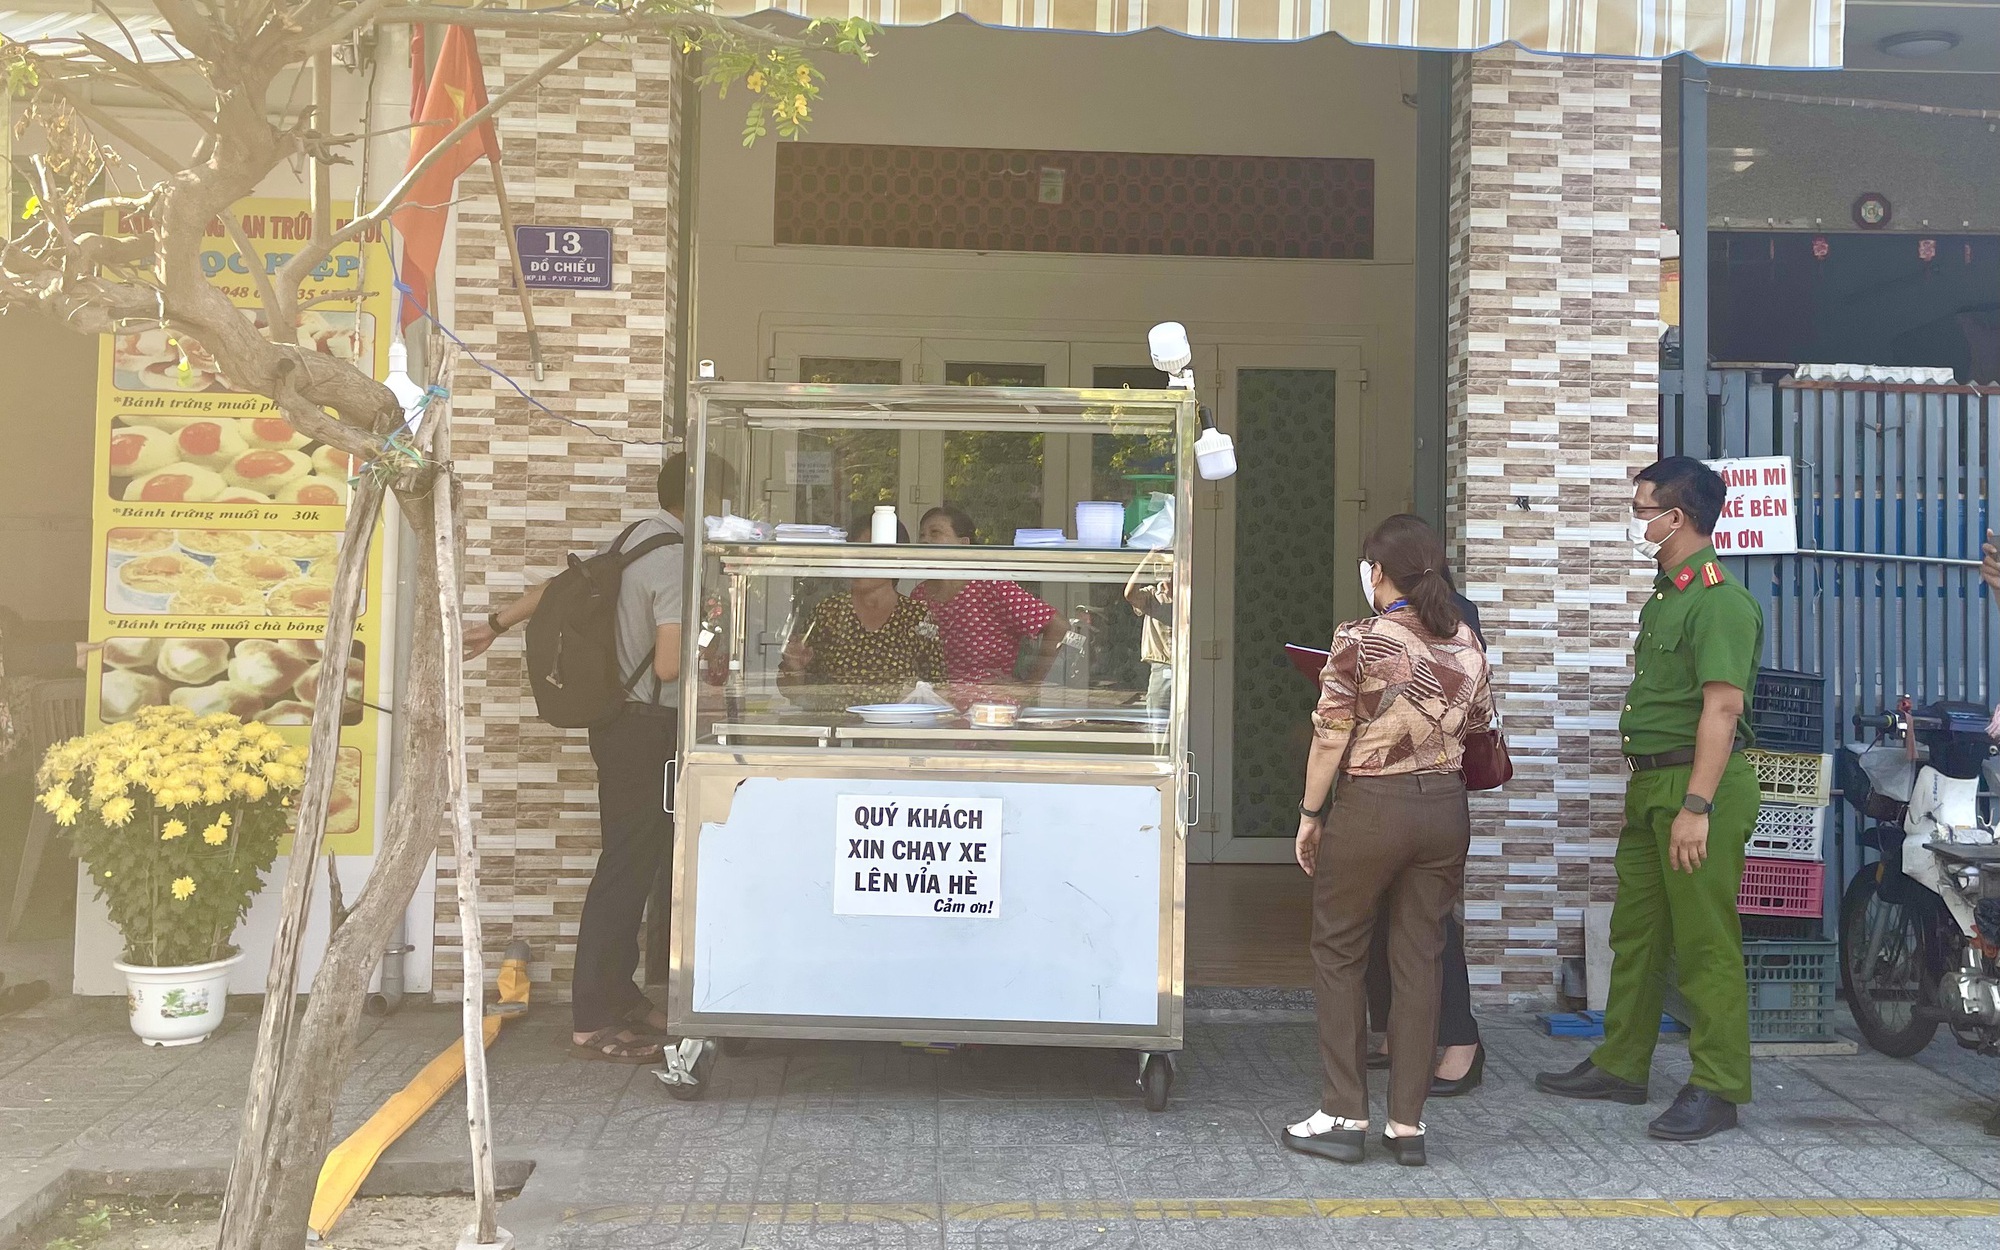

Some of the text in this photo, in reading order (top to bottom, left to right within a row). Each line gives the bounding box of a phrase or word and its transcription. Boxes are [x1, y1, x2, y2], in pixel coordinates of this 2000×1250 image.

[241, 214, 265, 239] AN
[545, 231, 582, 255] 13
[169, 397, 213, 412] trứng
[217, 398, 256, 411] muối
[1720, 463, 1787, 488] ÁNH MÌ
[170, 507, 213, 521] trứng
[219, 509, 260, 521] muối
[263, 511, 279, 521] to
[291, 510, 320, 522] 30k
[1721, 494, 1788, 519] KẾ BÊN
[1737, 529, 1764, 549] ƠN
[163, 619, 206, 633] trứng
[211, 620, 250, 631] muối
[254, 621, 281, 632] chà
[286, 622, 325, 634] bông
[854, 802, 983, 830] QUÝ KHÁCH
[847, 839, 987, 866] XIN CHẠY XE
[854, 866, 978, 895] LÊN VỈA HÈ
[933, 898, 994, 914] Cảm ơn!
